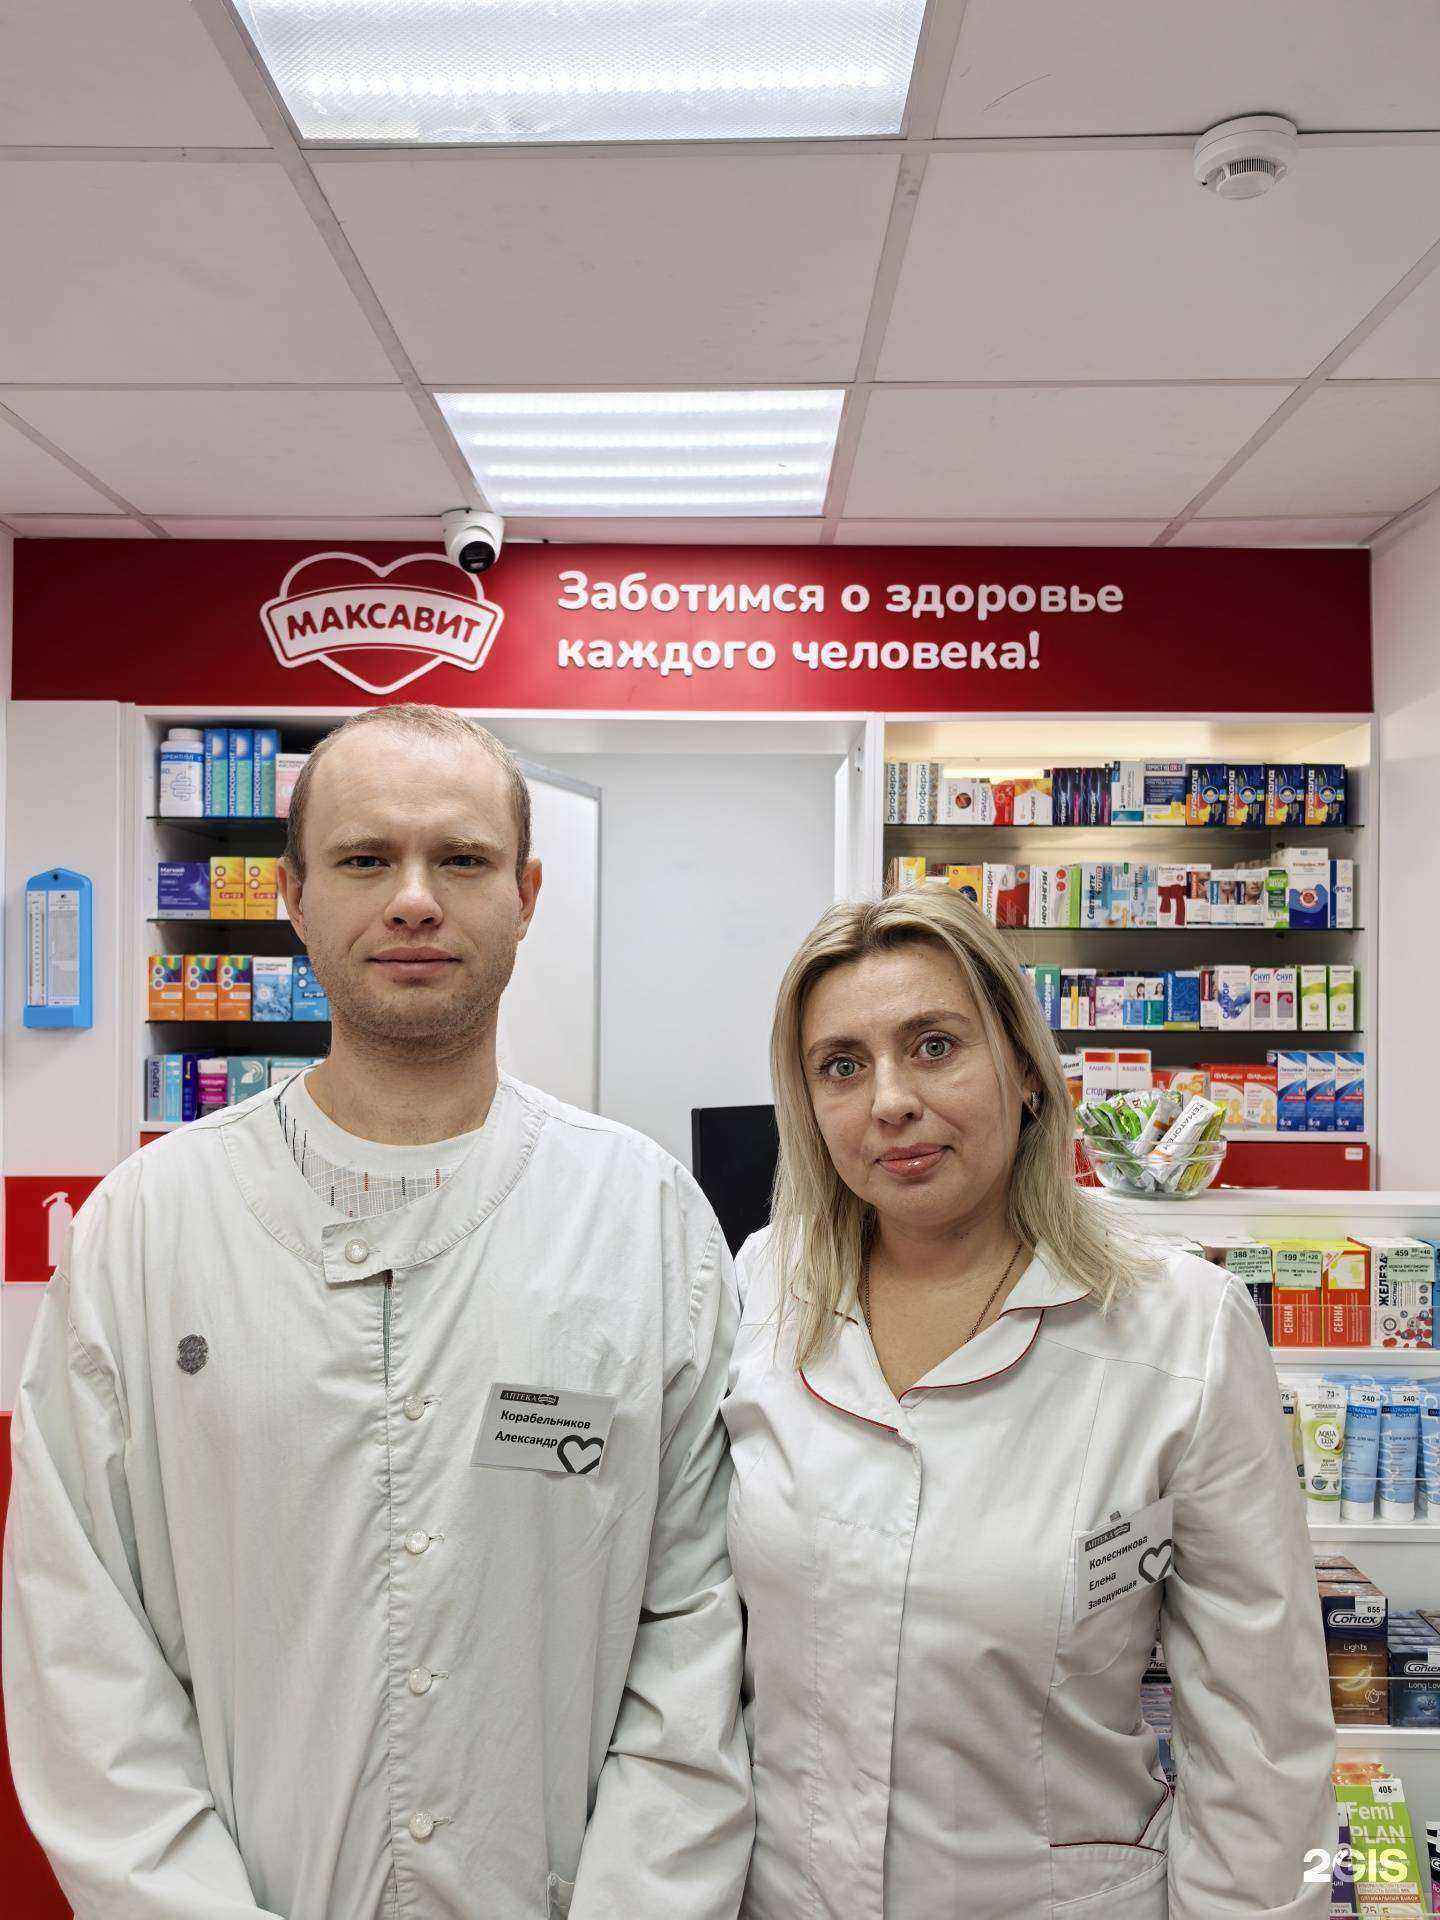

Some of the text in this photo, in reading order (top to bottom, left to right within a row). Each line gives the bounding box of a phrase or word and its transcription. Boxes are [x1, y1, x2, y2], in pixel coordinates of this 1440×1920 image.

[557, 570, 1125, 621] Заботимся о здоровье
[286, 602, 481, 644] МАКСАВИТ
[557, 631, 1041, 676] каждого человека!
[887, 763, 897, 822] Эргоферон
[918, 764, 929, 823] Эргоферон
[1253, 973, 1270, 981] СНУП
[1276, 973, 1293, 981] СНУП
[1395, 1249, 1409, 1257] 459
[500, 1410, 592, 1430] Корабельников
[494, 1430, 558, 1449] Александр
[1318, 1430, 1337, 1439] AQUA
[1089, 1535, 1149, 1570] Колесникова
[1089, 1572, 1117, 1591] Елена
[1088, 1580, 1137, 1610] Заведующая
[1332, 1613, 1377, 1624] Contex
[1343, 1643, 1368, 1653] Lights
[1408, 1682, 1427, 1690] Long
[1378, 1785, 1393, 1794] 405
[1349, 1802, 1395, 1820] Femi
[1351, 1825, 1407, 1844] PLAN
